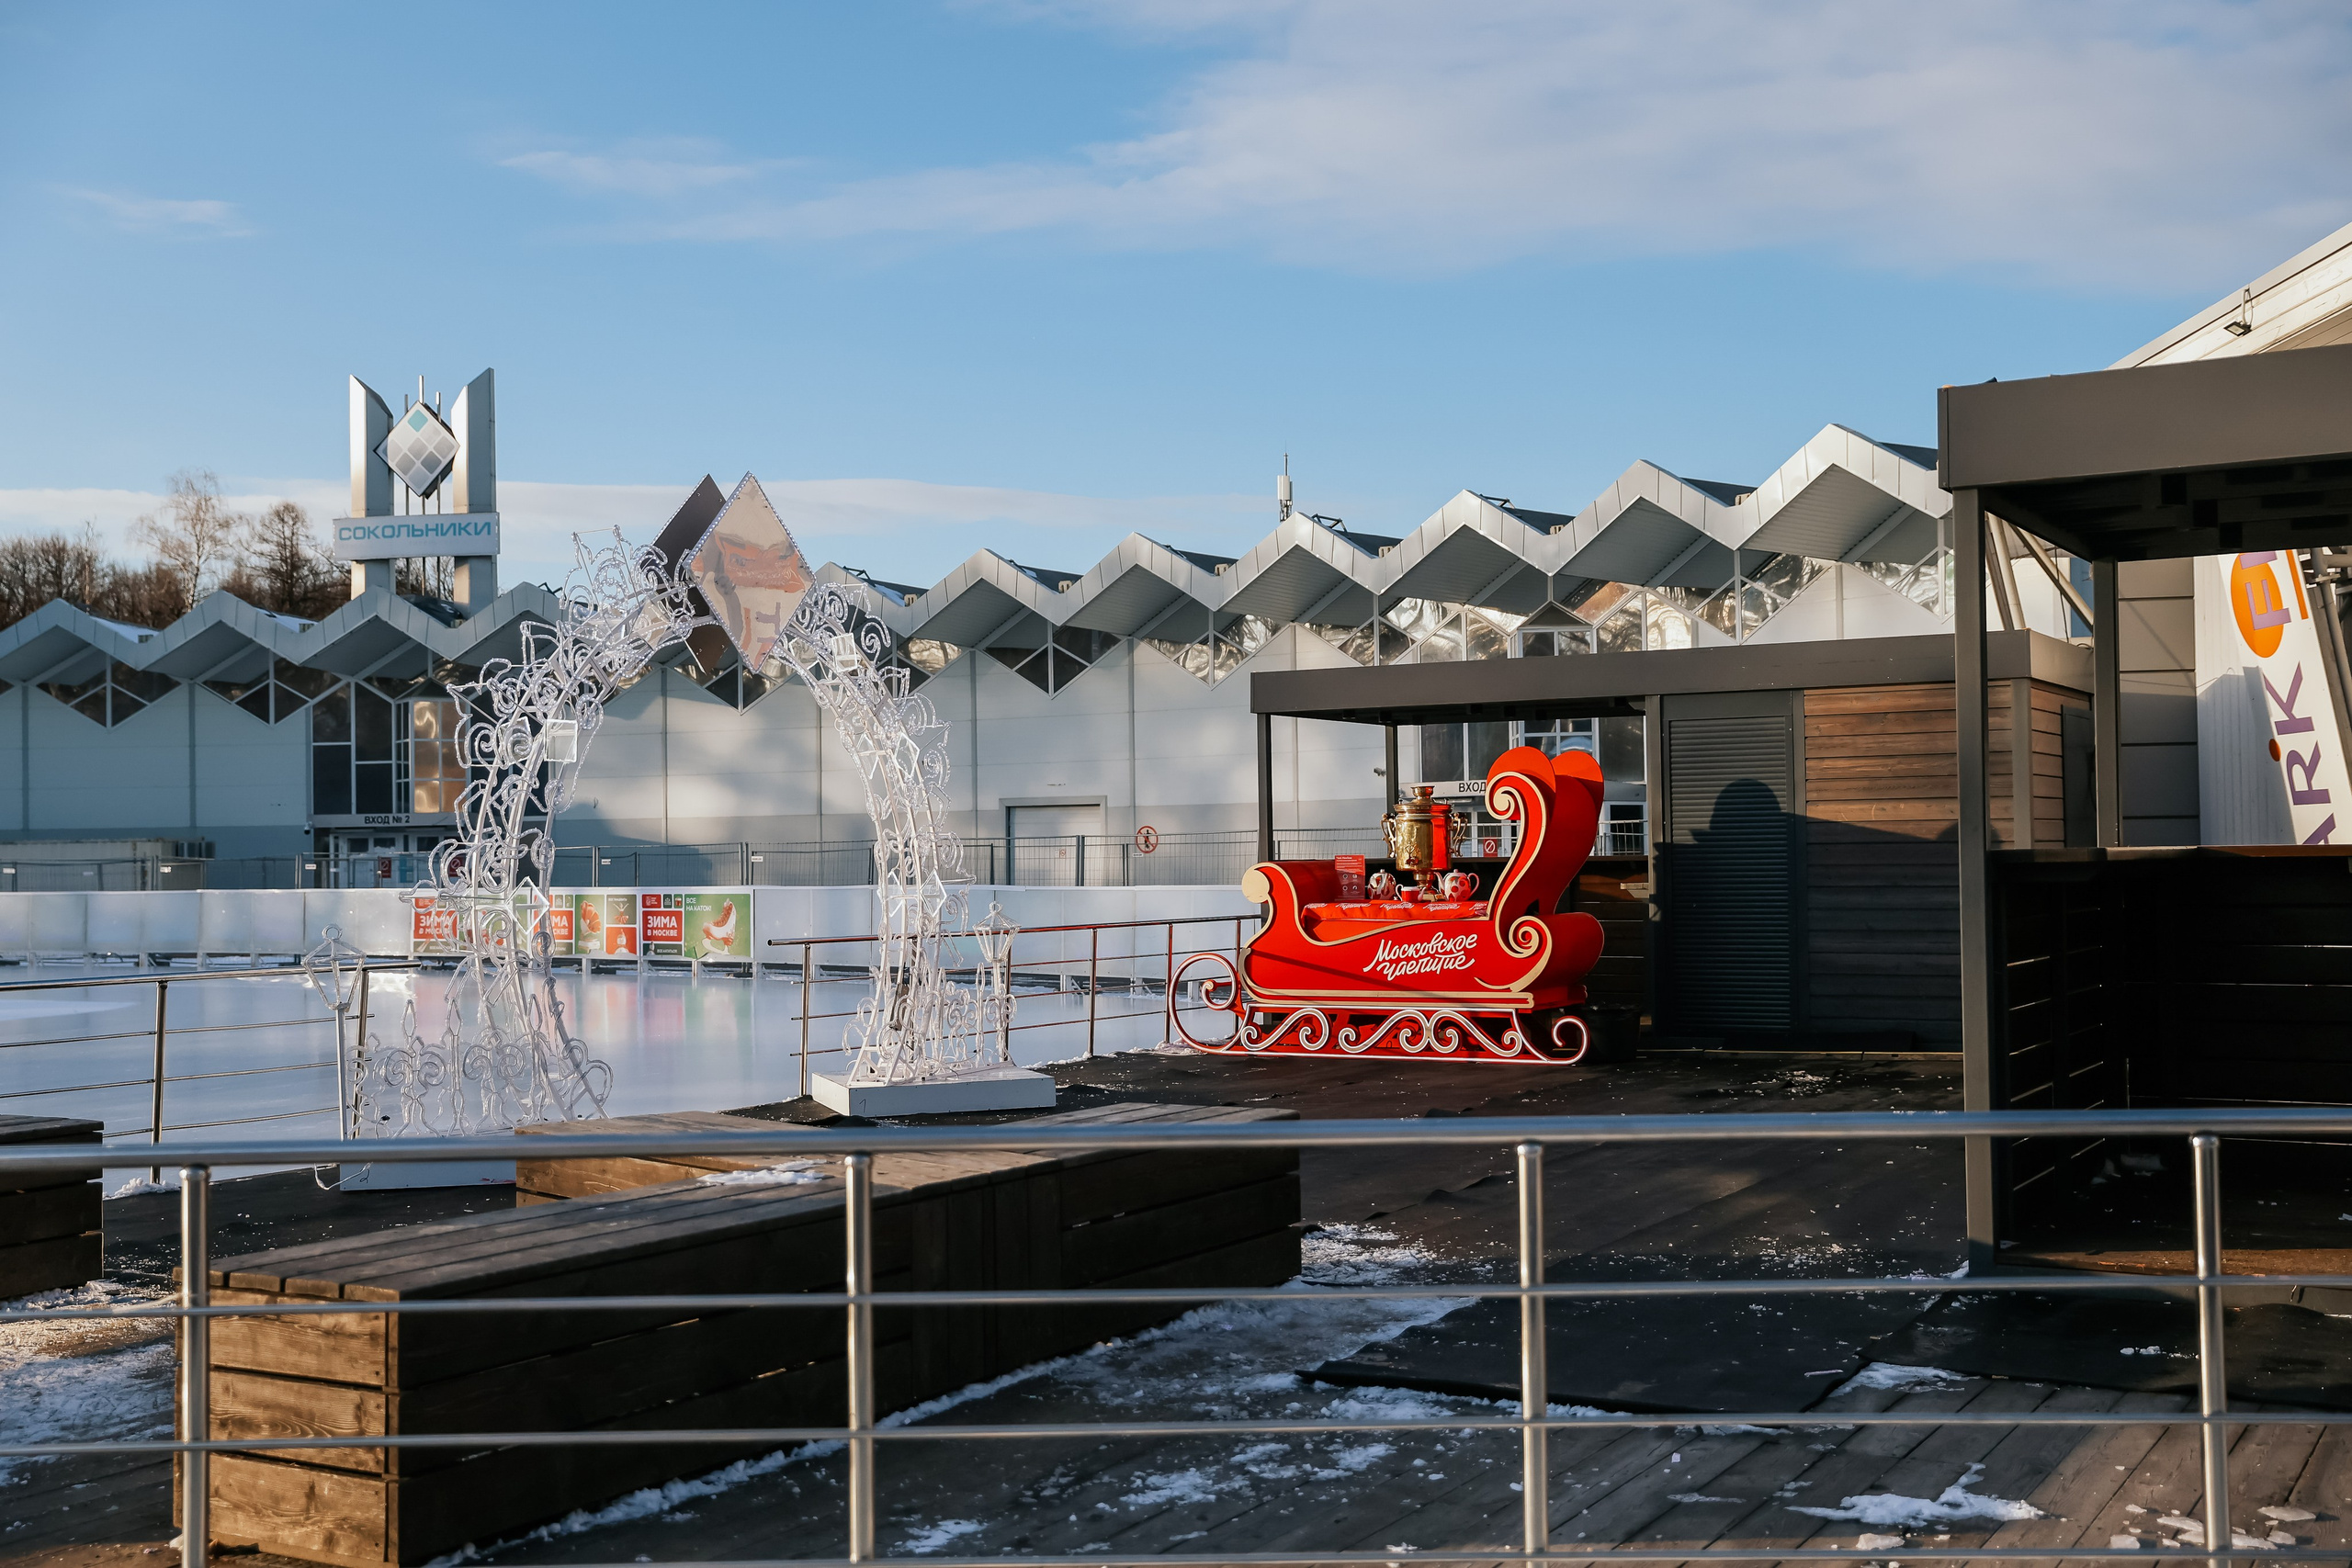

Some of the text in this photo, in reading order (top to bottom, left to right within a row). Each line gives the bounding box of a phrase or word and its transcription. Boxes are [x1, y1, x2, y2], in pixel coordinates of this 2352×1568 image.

[339, 521, 492, 541] СОКОЛЬНИКИ
[1459, 782, 1486, 793] ВХОД
[365, 815, 411, 825] ВХОД № 2
[647, 916, 678, 929] ЗИМА
[1363, 931, 1477, 973] Московское
[1376, 950, 1476, 981] чаепитие
